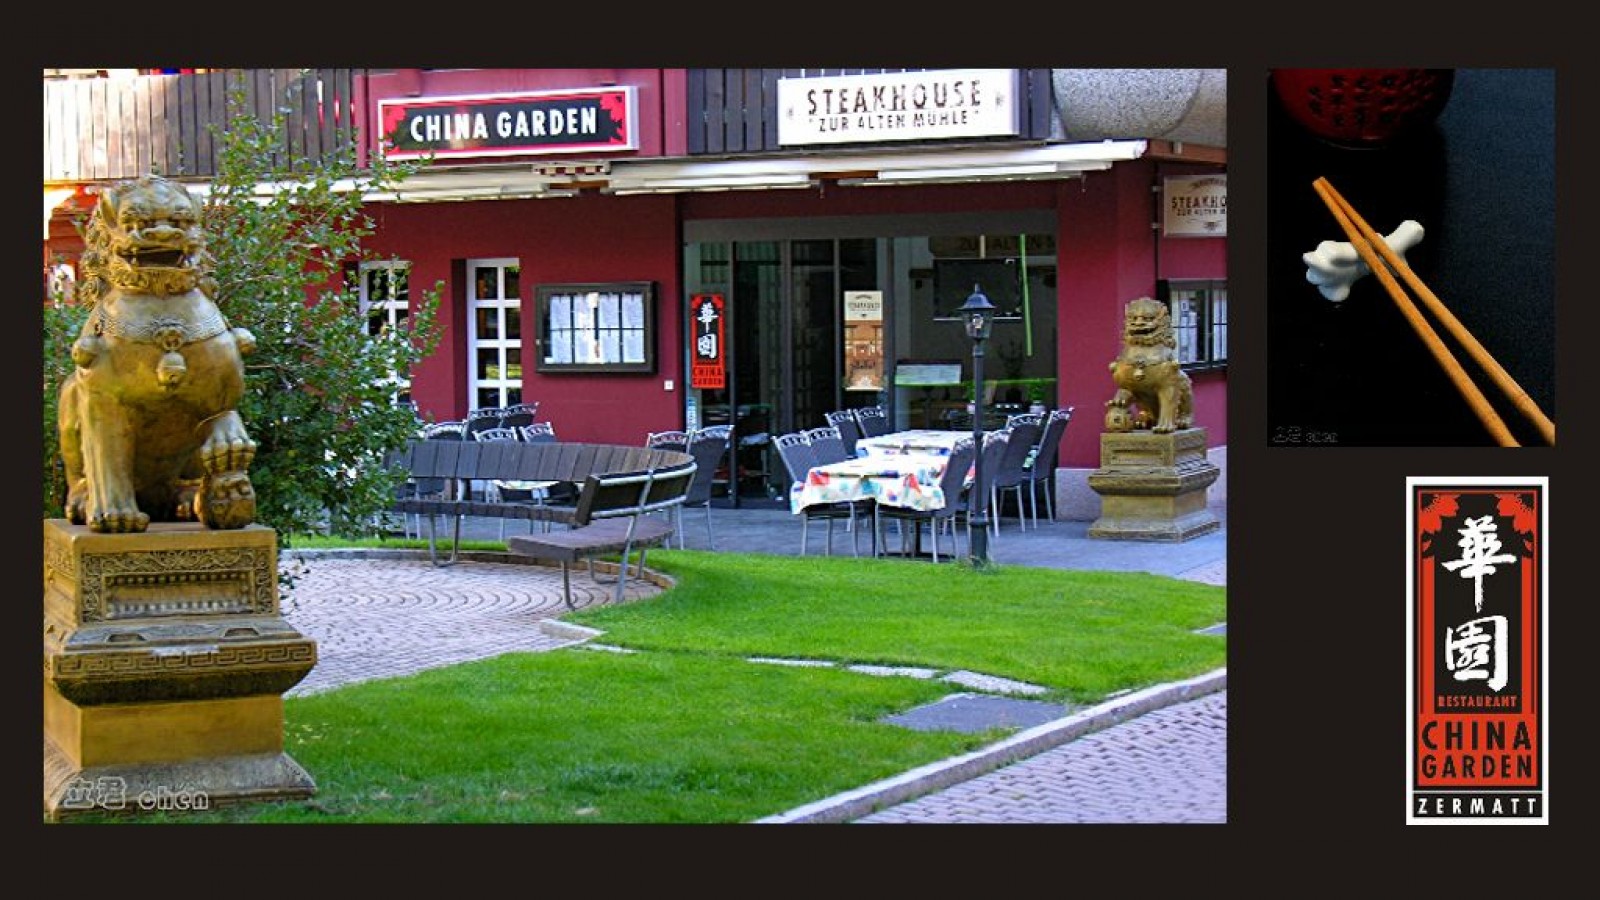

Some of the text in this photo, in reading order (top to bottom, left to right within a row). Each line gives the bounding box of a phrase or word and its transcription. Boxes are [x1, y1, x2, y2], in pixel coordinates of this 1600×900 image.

[806, 79, 981, 115] STEAKHOUSE
[410, 107, 596, 142] CHINA GARDEN
[1438, 695, 1518, 708] RESTAURANT
[1420, 721, 1533, 752] CHINA
[1420, 754, 1534, 780] GARDEN
[1417, 797, 1538, 816] ZERMATT
